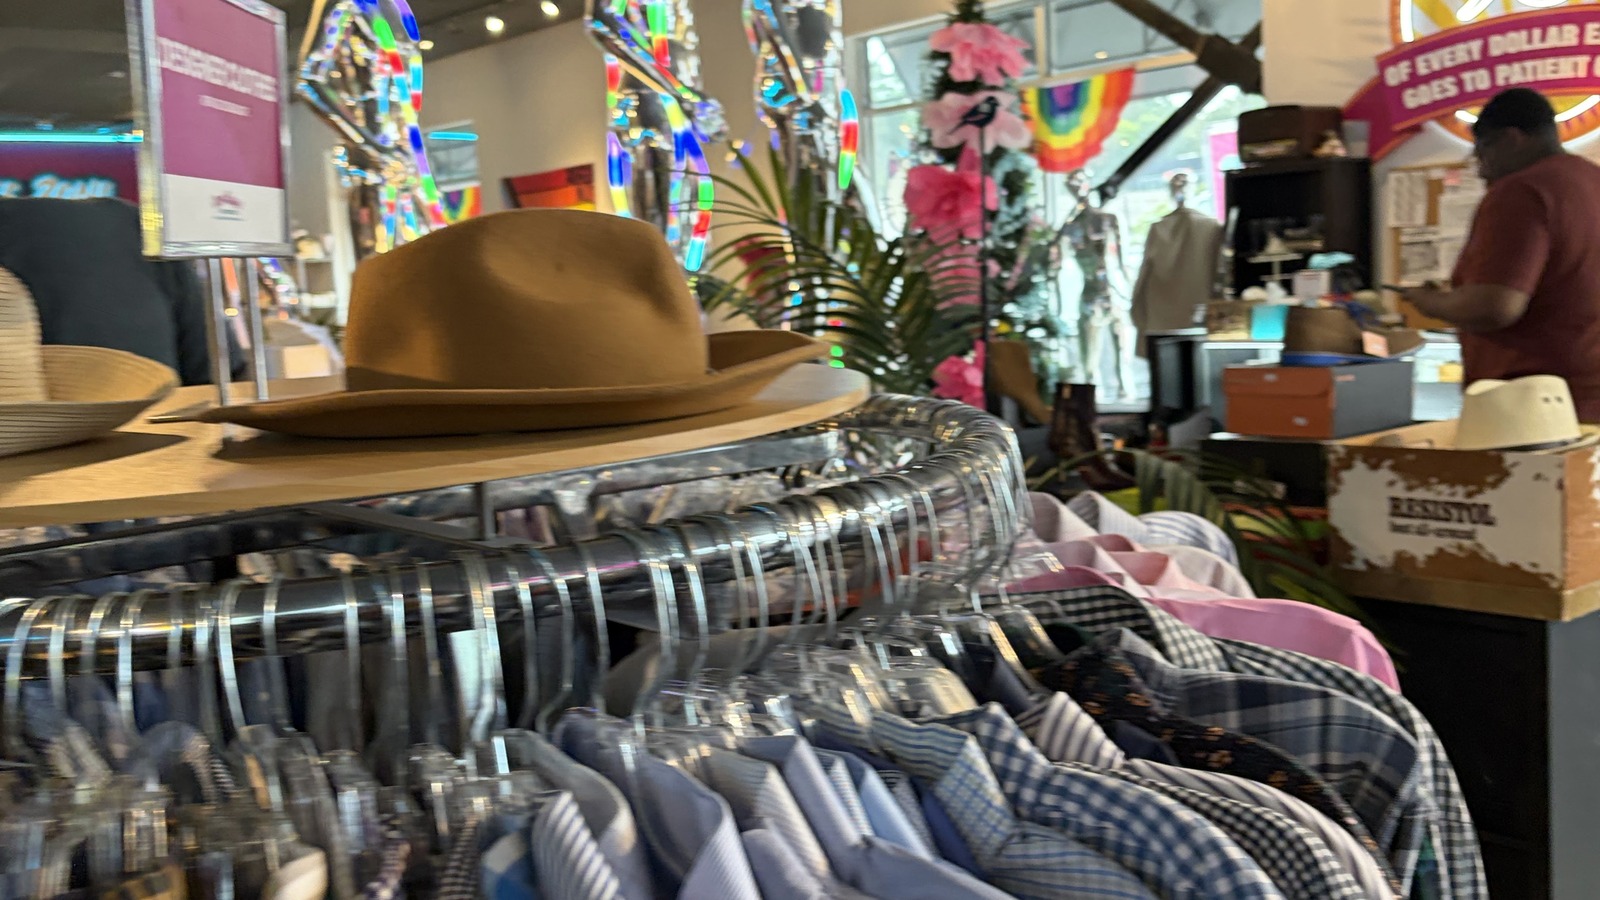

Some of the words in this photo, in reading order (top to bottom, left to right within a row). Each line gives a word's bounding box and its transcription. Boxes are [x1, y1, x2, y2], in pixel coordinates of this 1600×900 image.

[1384, 60, 1412, 86] OF
[1415, 39, 1484, 76] EVERY
[1488, 24, 1579, 56] DOLLAR
[1402, 77, 1459, 109] GOES
[1461, 69, 1491, 92] TO
[1495, 55, 1590, 86] PATIENT
[1389, 497, 1496, 526] RESISTOL
